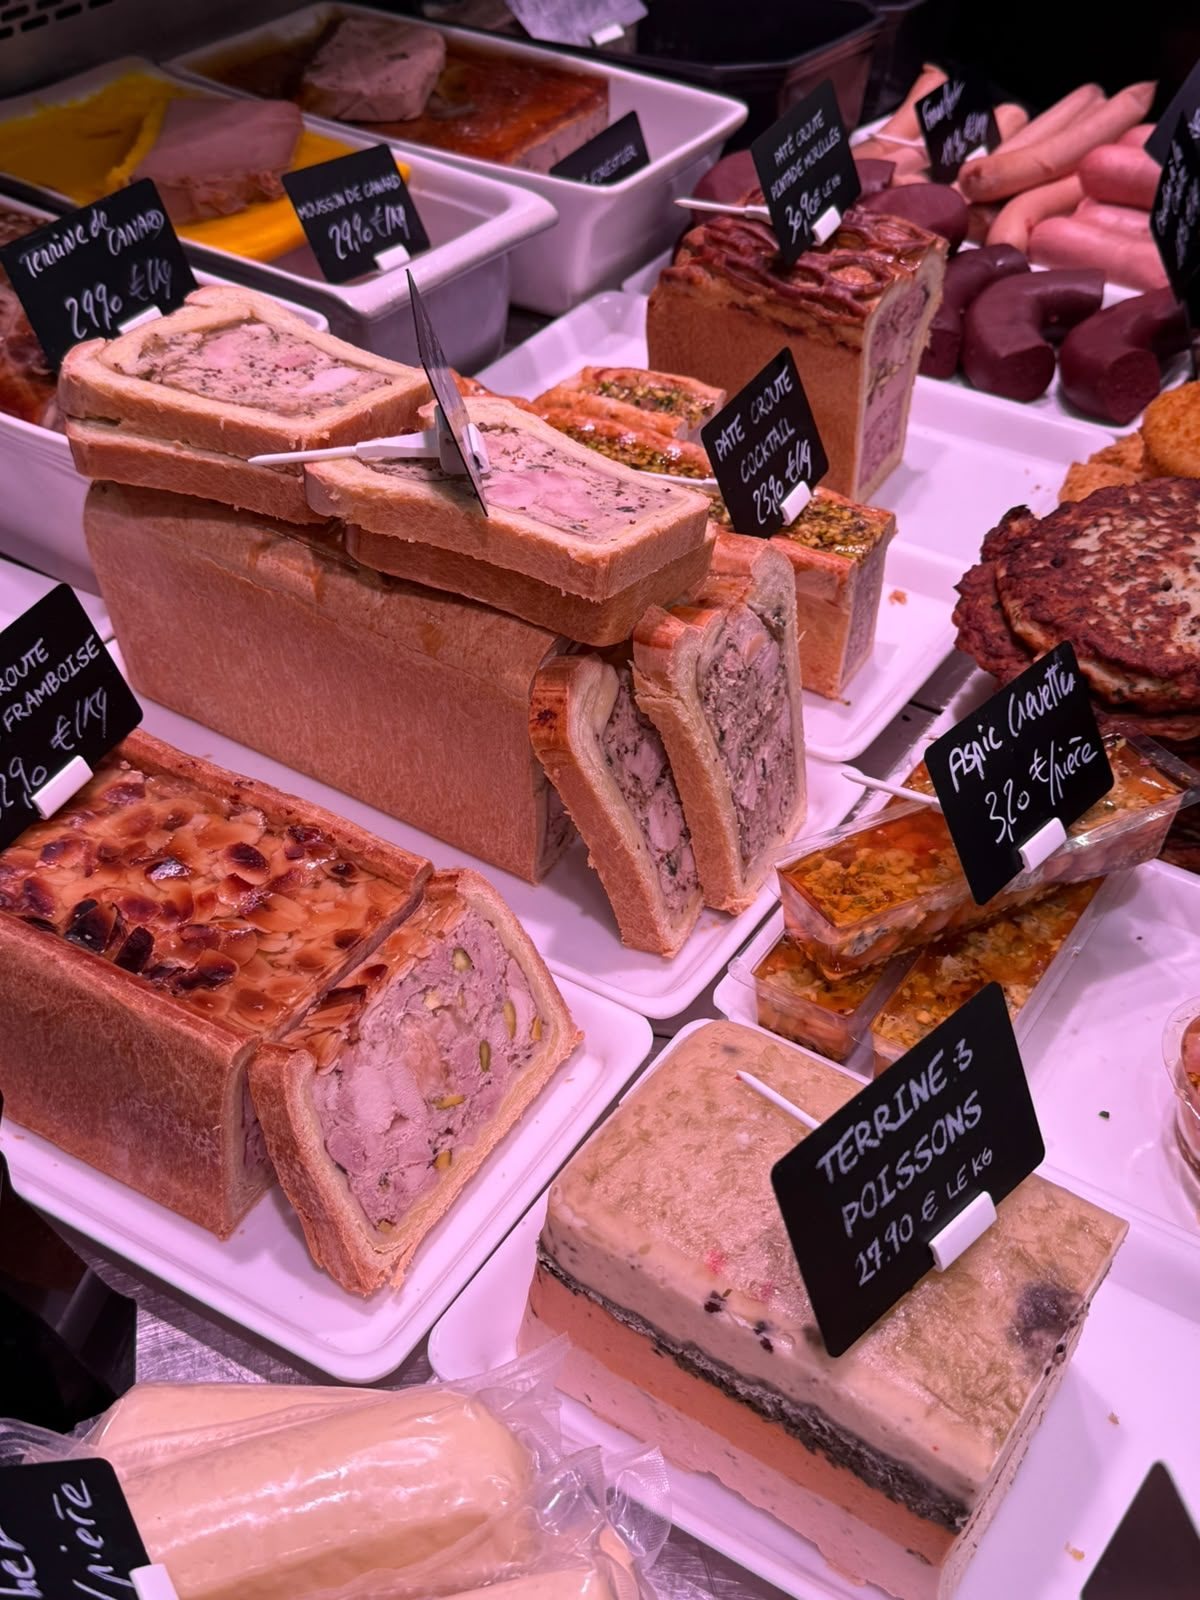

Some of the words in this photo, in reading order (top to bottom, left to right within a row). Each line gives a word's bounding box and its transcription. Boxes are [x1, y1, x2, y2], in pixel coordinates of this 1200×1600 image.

[90, 209, 112, 238] de
[345, 185, 362, 203] DE
[714, 413, 746, 462] PATE
[750, 365, 793, 424] CROUTE
[740, 417, 796, 484] COCKTAIL
[3, 634, 100, 732] FRAMBOISE
[816, 1048, 948, 1184] TERRINE
[841, 1089, 983, 1238] POISSONS
[945, 1163, 968, 1199] LE
[970, 1147, 993, 1177] KG
